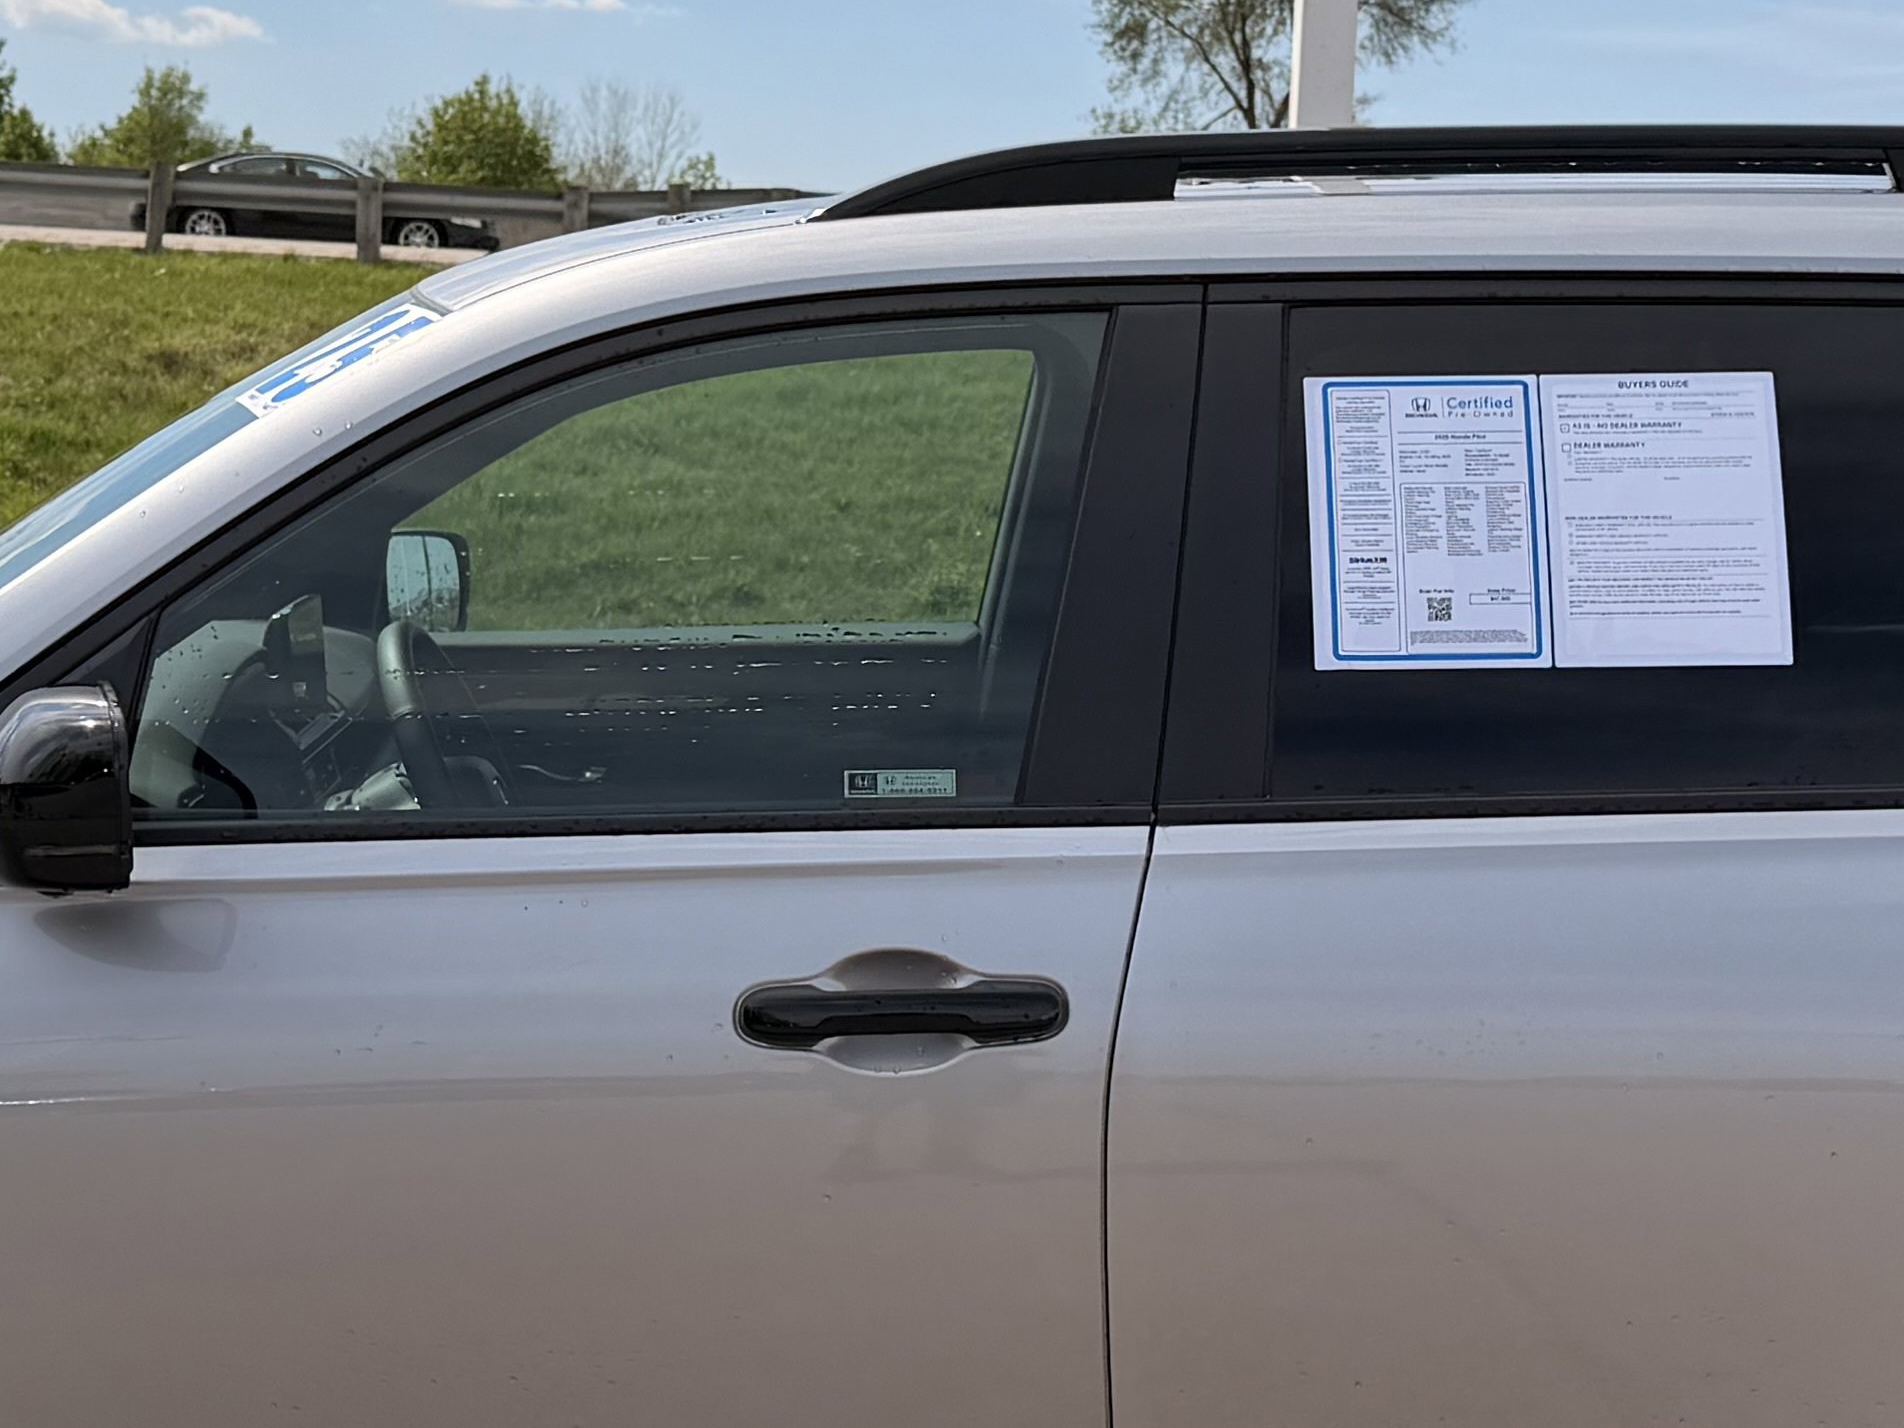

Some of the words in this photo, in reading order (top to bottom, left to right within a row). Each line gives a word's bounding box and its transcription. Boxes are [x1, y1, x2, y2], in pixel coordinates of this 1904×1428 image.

[1617, 380, 1657, 389] BUYERS
[1659, 379, 1689, 388] GUIDE
[1446, 395, 1513, 410] Certified
[1447, 410, 1514, 418] Pre-Owned
